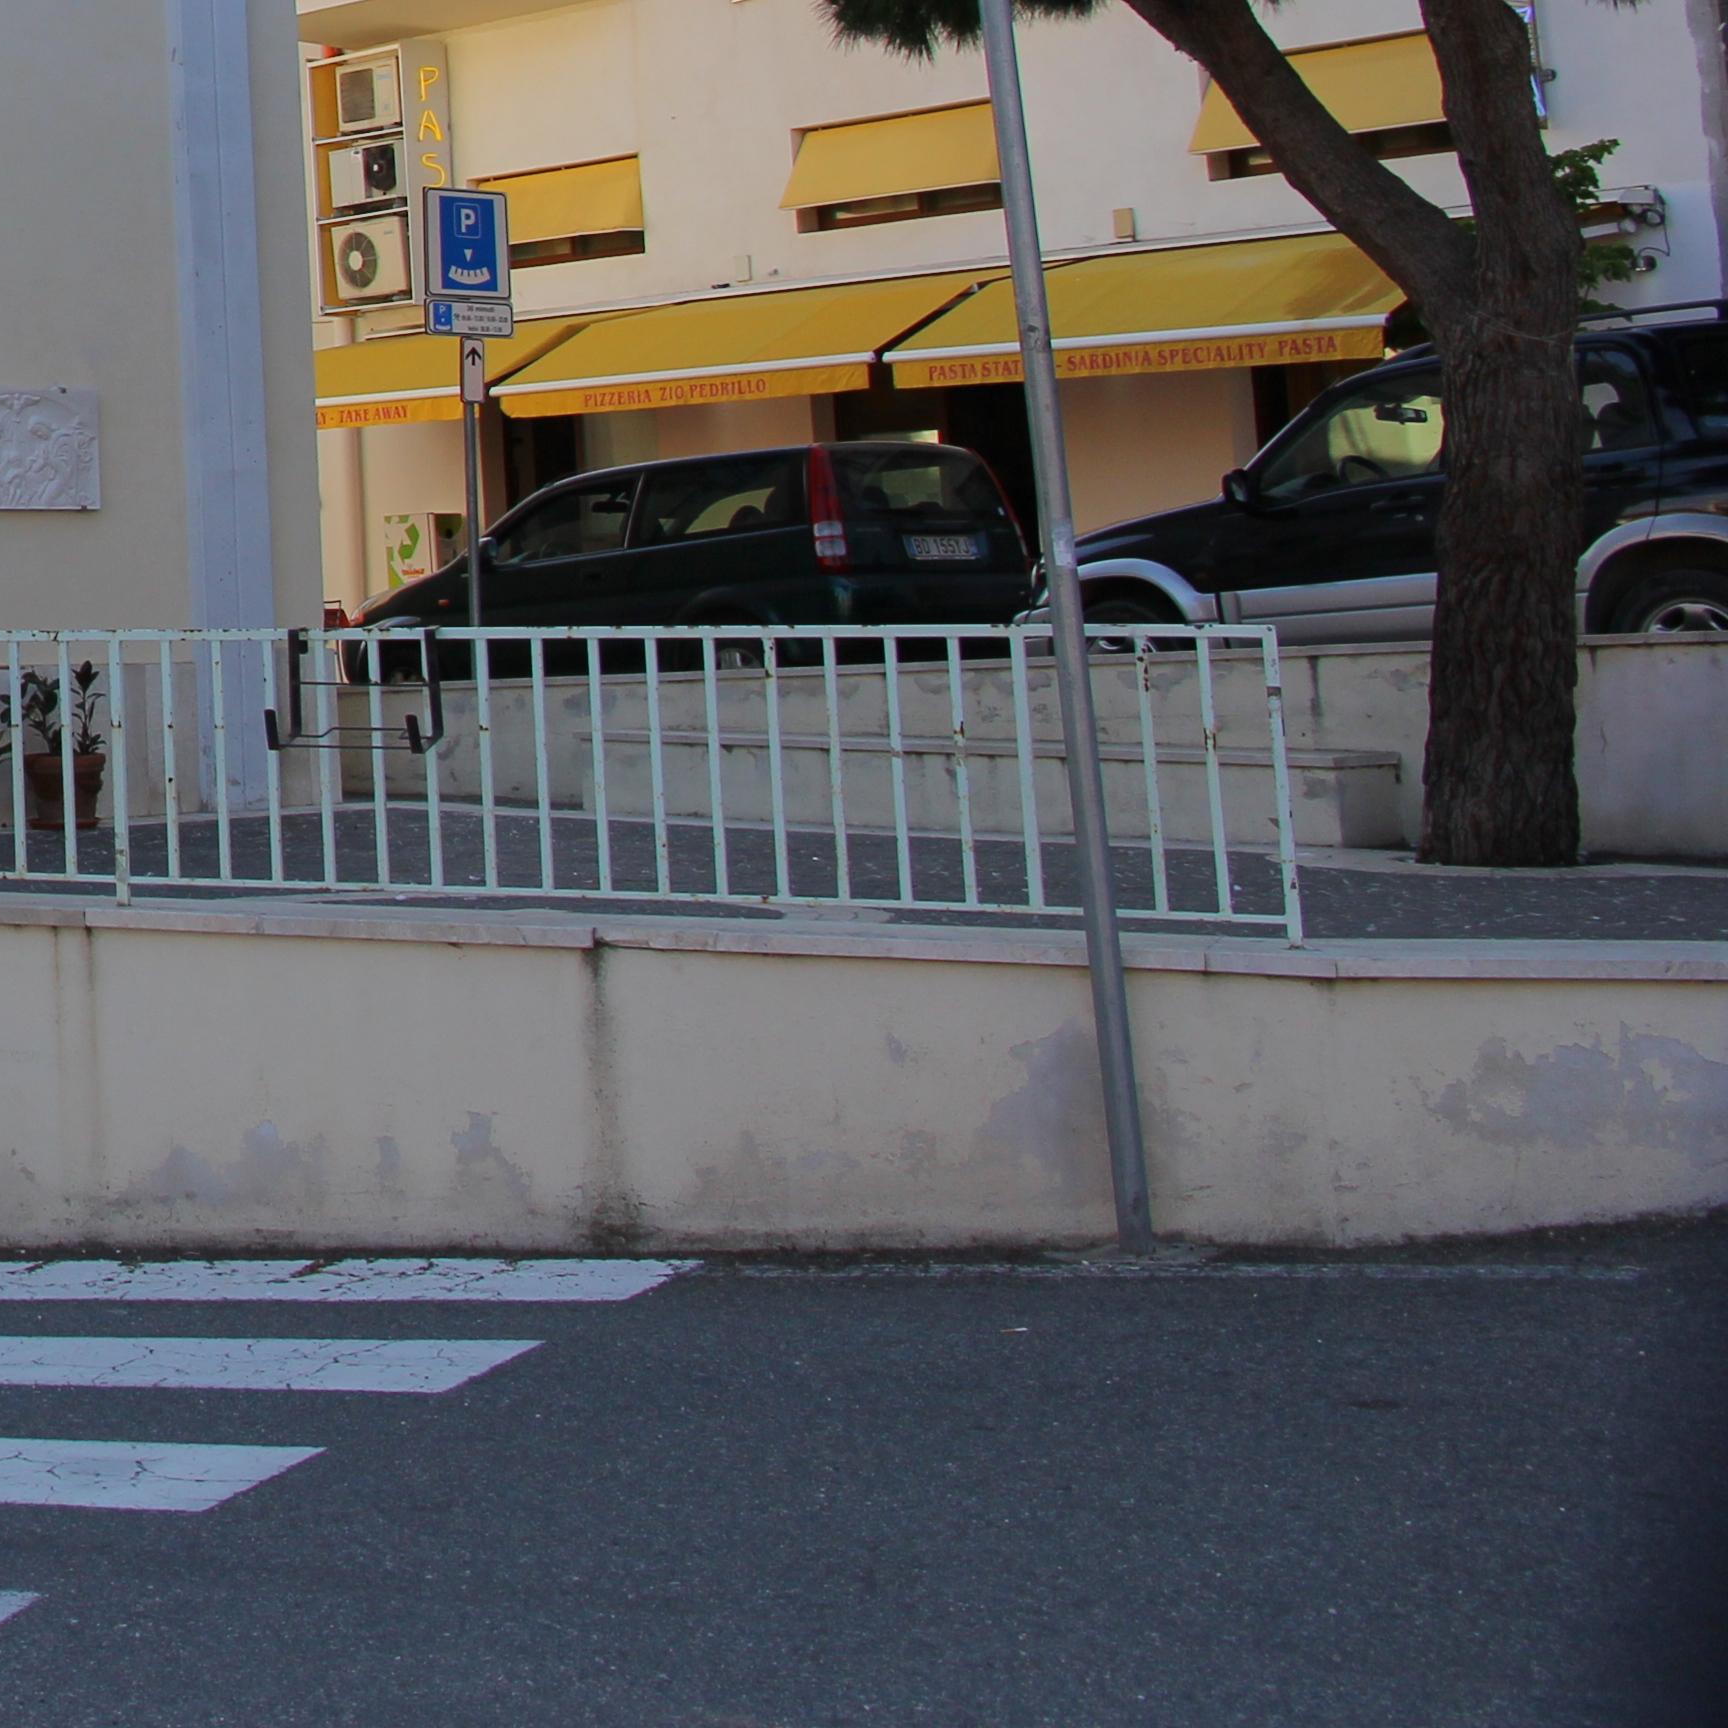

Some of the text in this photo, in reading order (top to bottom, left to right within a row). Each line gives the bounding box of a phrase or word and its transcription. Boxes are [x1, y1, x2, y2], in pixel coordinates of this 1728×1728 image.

[928, 364, 977, 382] PASTA
[1067, 350, 1153, 372] SARDINIA
[1157, 341, 1268, 366] SPECIALITY
[1278, 335, 1338, 357] PASTA
[583, 378, 767, 408] PIZZERIA ZIO PEDRILLO
[338, 409, 370, 424] TAKE
[374, 404, 409, 421] AWAY
